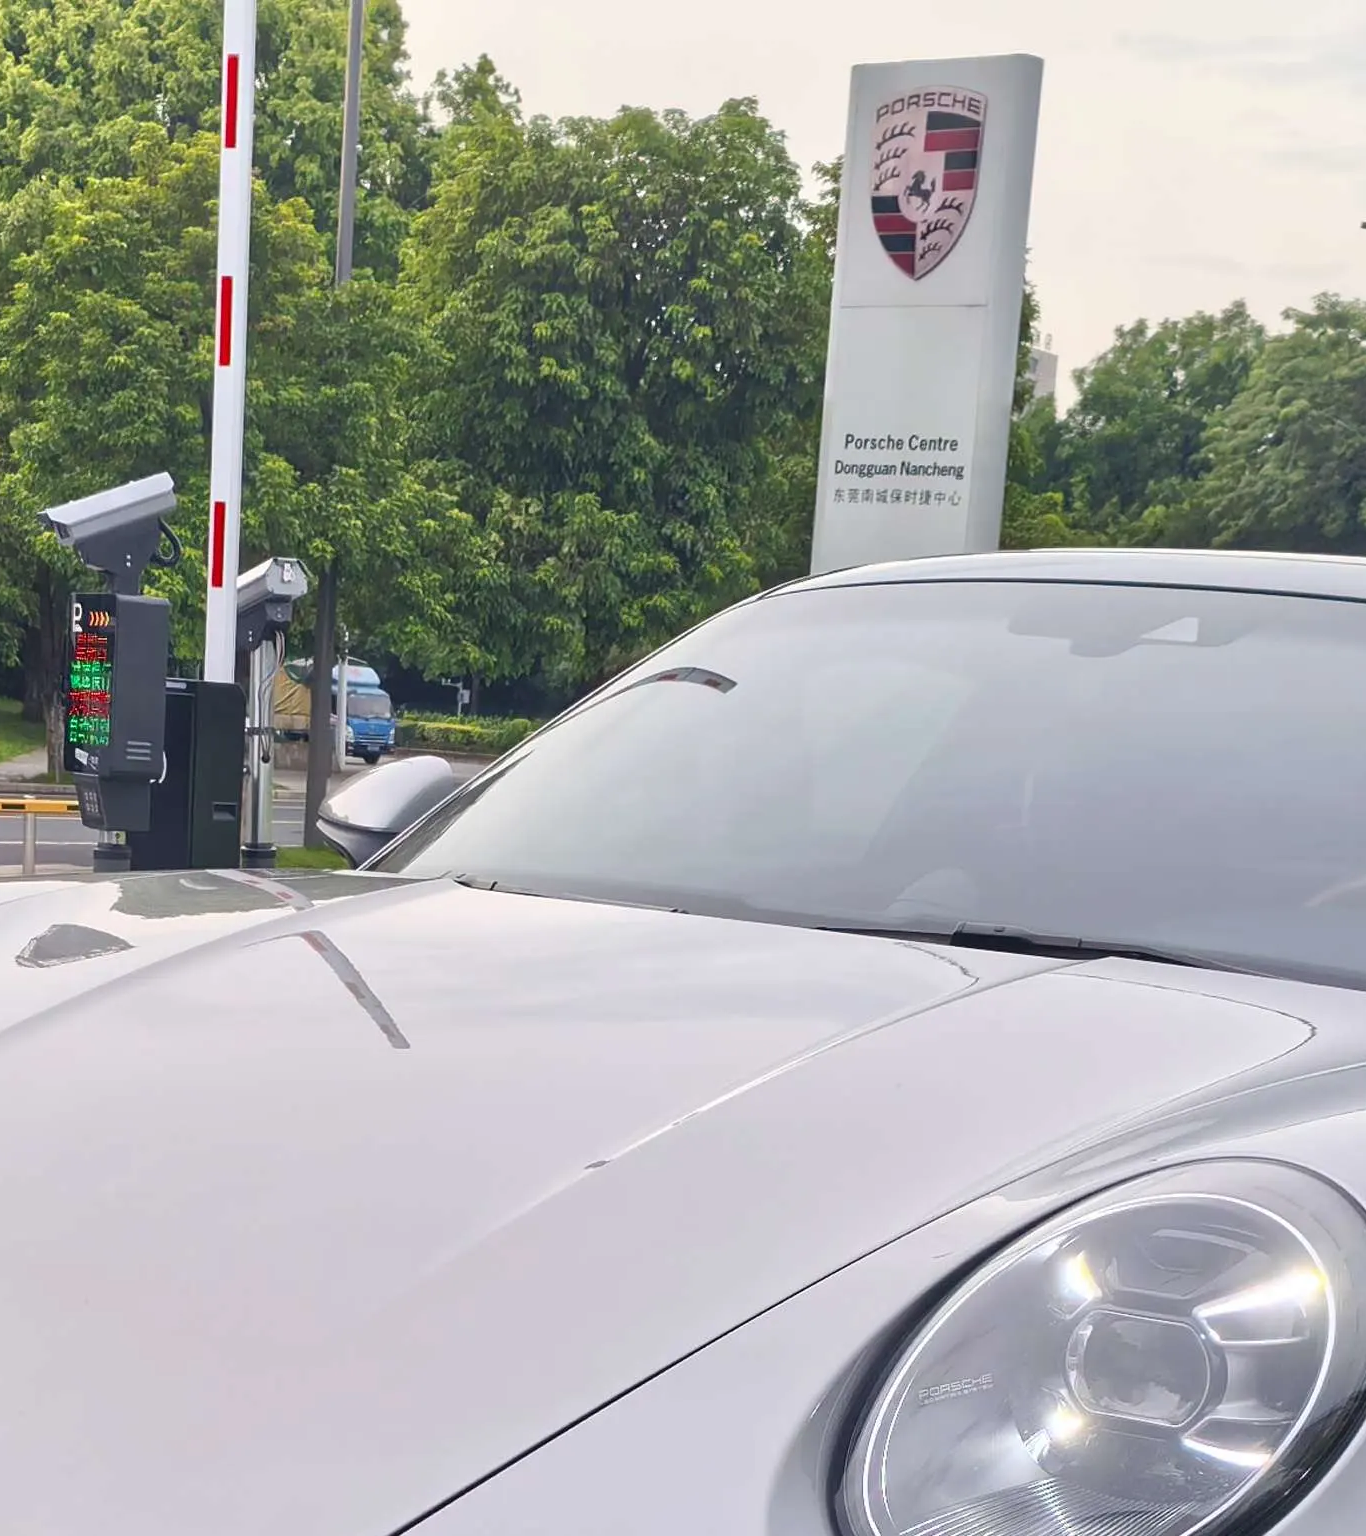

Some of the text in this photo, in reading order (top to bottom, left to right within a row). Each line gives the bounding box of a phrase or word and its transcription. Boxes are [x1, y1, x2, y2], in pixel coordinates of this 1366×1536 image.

[876, 92, 981, 123] PORSCHE
[844, 433, 959, 452] Porsche Centre
[834, 460, 964, 480] Dongguan Nancheng
[834, 487, 962, 506] 东莞南城保时捷中心
[918, 1373, 993, 1400] PORSCHE
